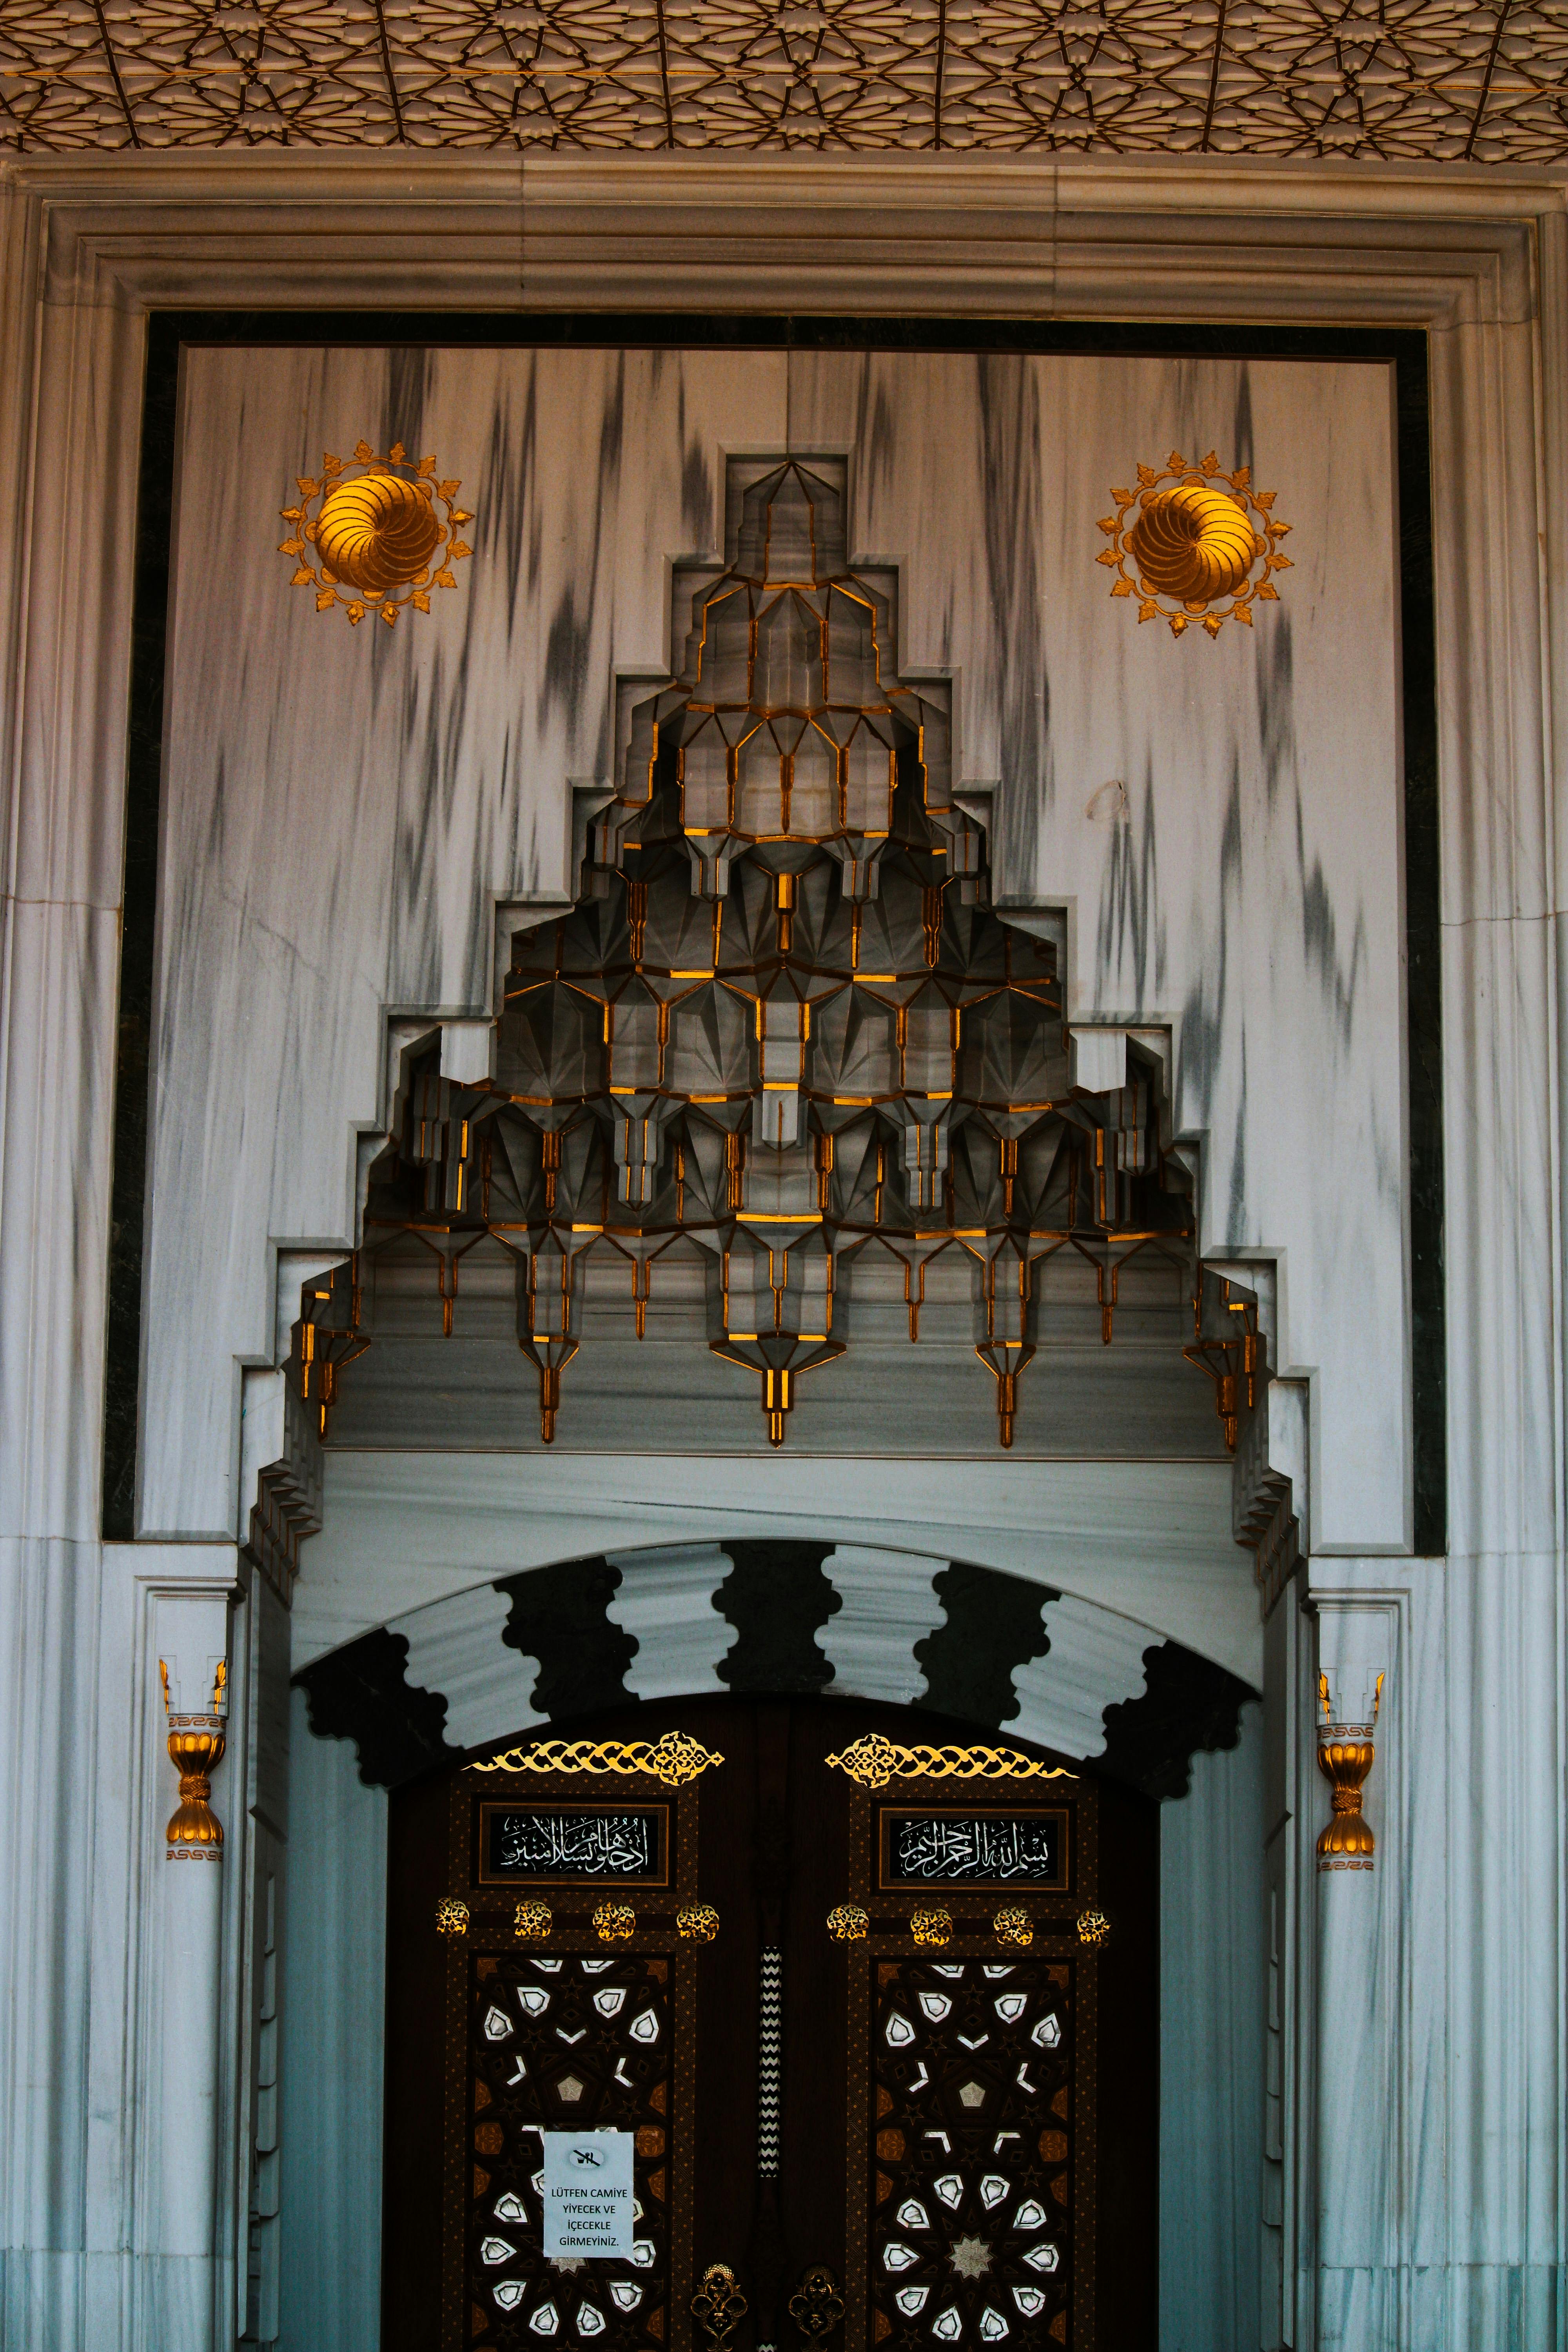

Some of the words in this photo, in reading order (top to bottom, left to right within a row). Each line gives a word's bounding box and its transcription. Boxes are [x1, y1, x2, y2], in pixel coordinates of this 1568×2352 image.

[552, 2187, 588, 2198] LÜTFEN
[590, 2187, 628, 2198] CAMİYE
[563, 2203, 601, 2214] YİYECEK
[603, 2205, 616, 2214] VE
[568, 2219, 611, 2232] İÇECEKLE
[560, 2236, 619, 2246] GİRMEYİNİZ.
